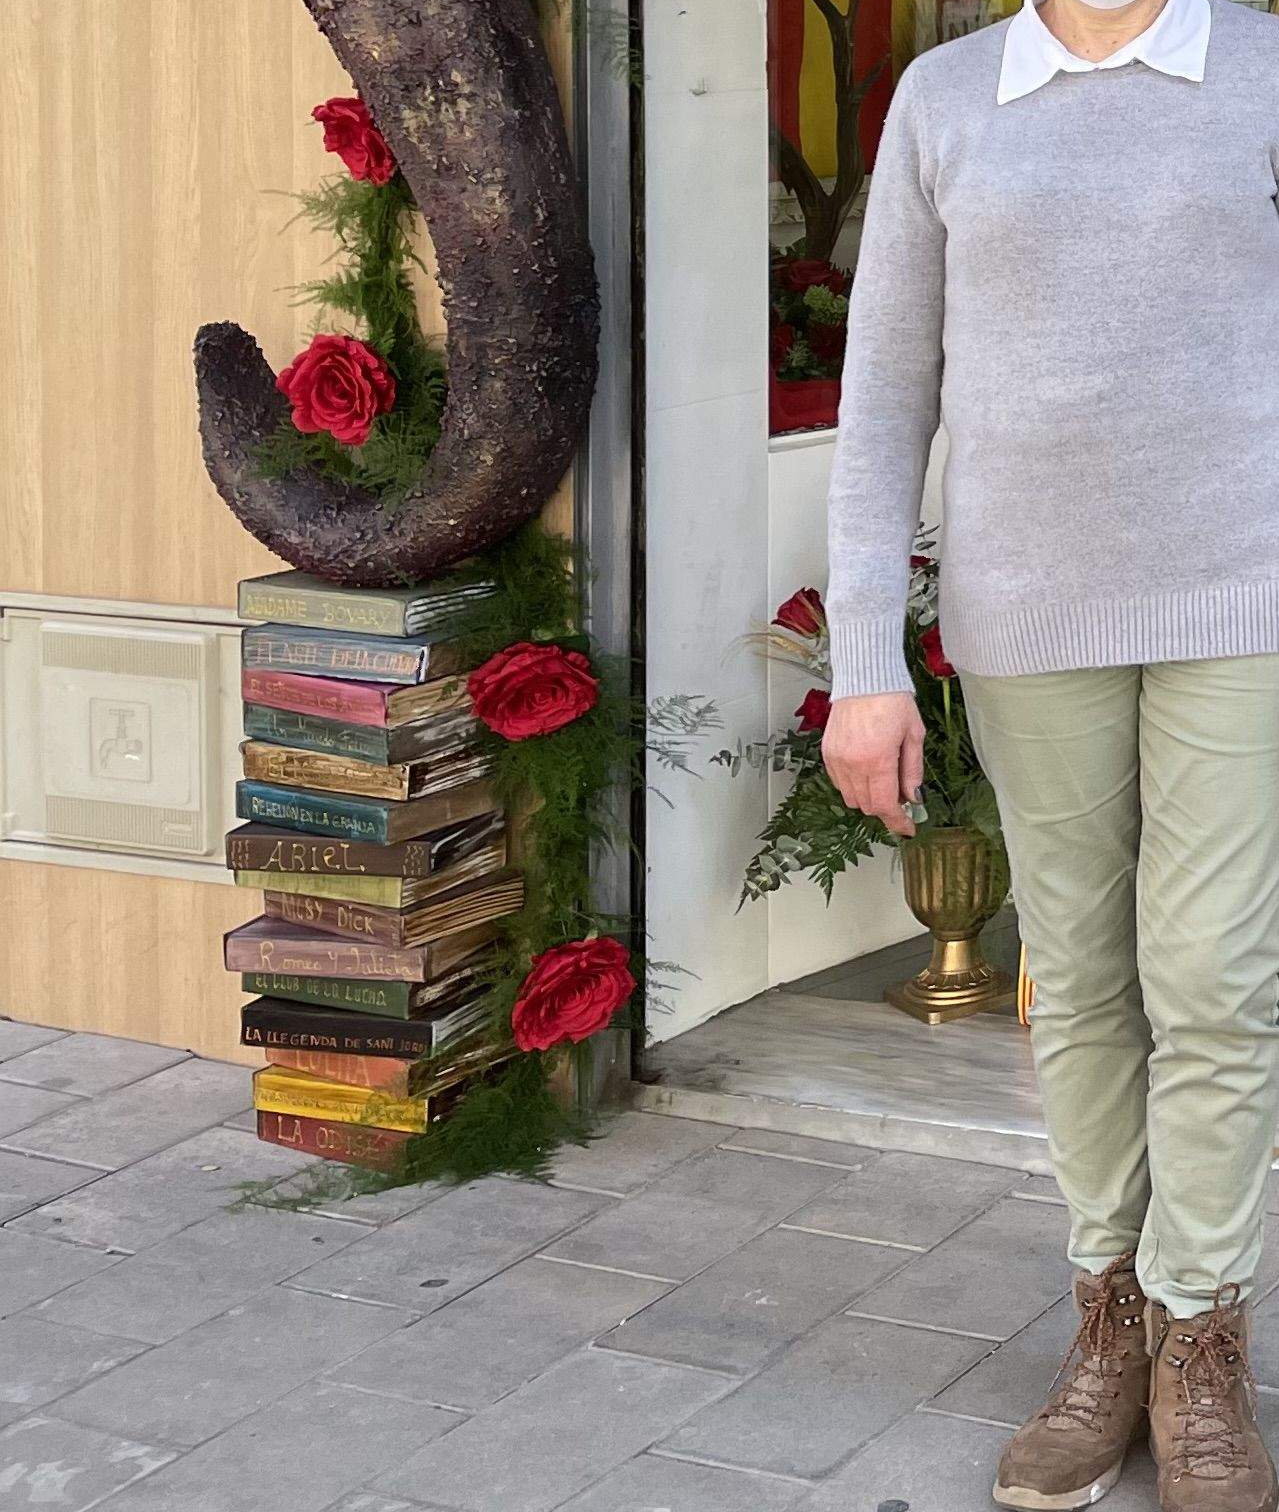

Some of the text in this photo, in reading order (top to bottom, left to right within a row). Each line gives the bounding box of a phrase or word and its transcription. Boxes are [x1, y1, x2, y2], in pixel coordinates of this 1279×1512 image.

[321, 602, 391, 630] BOVARY
[246, 1026, 262, 1042] LA
[266, 1030, 337, 1049] LLEGENDA
[345, 1037, 361, 1049] DE
[366, 1037, 394, 1050] SANT
[277, 1115, 304, 1145] LA
